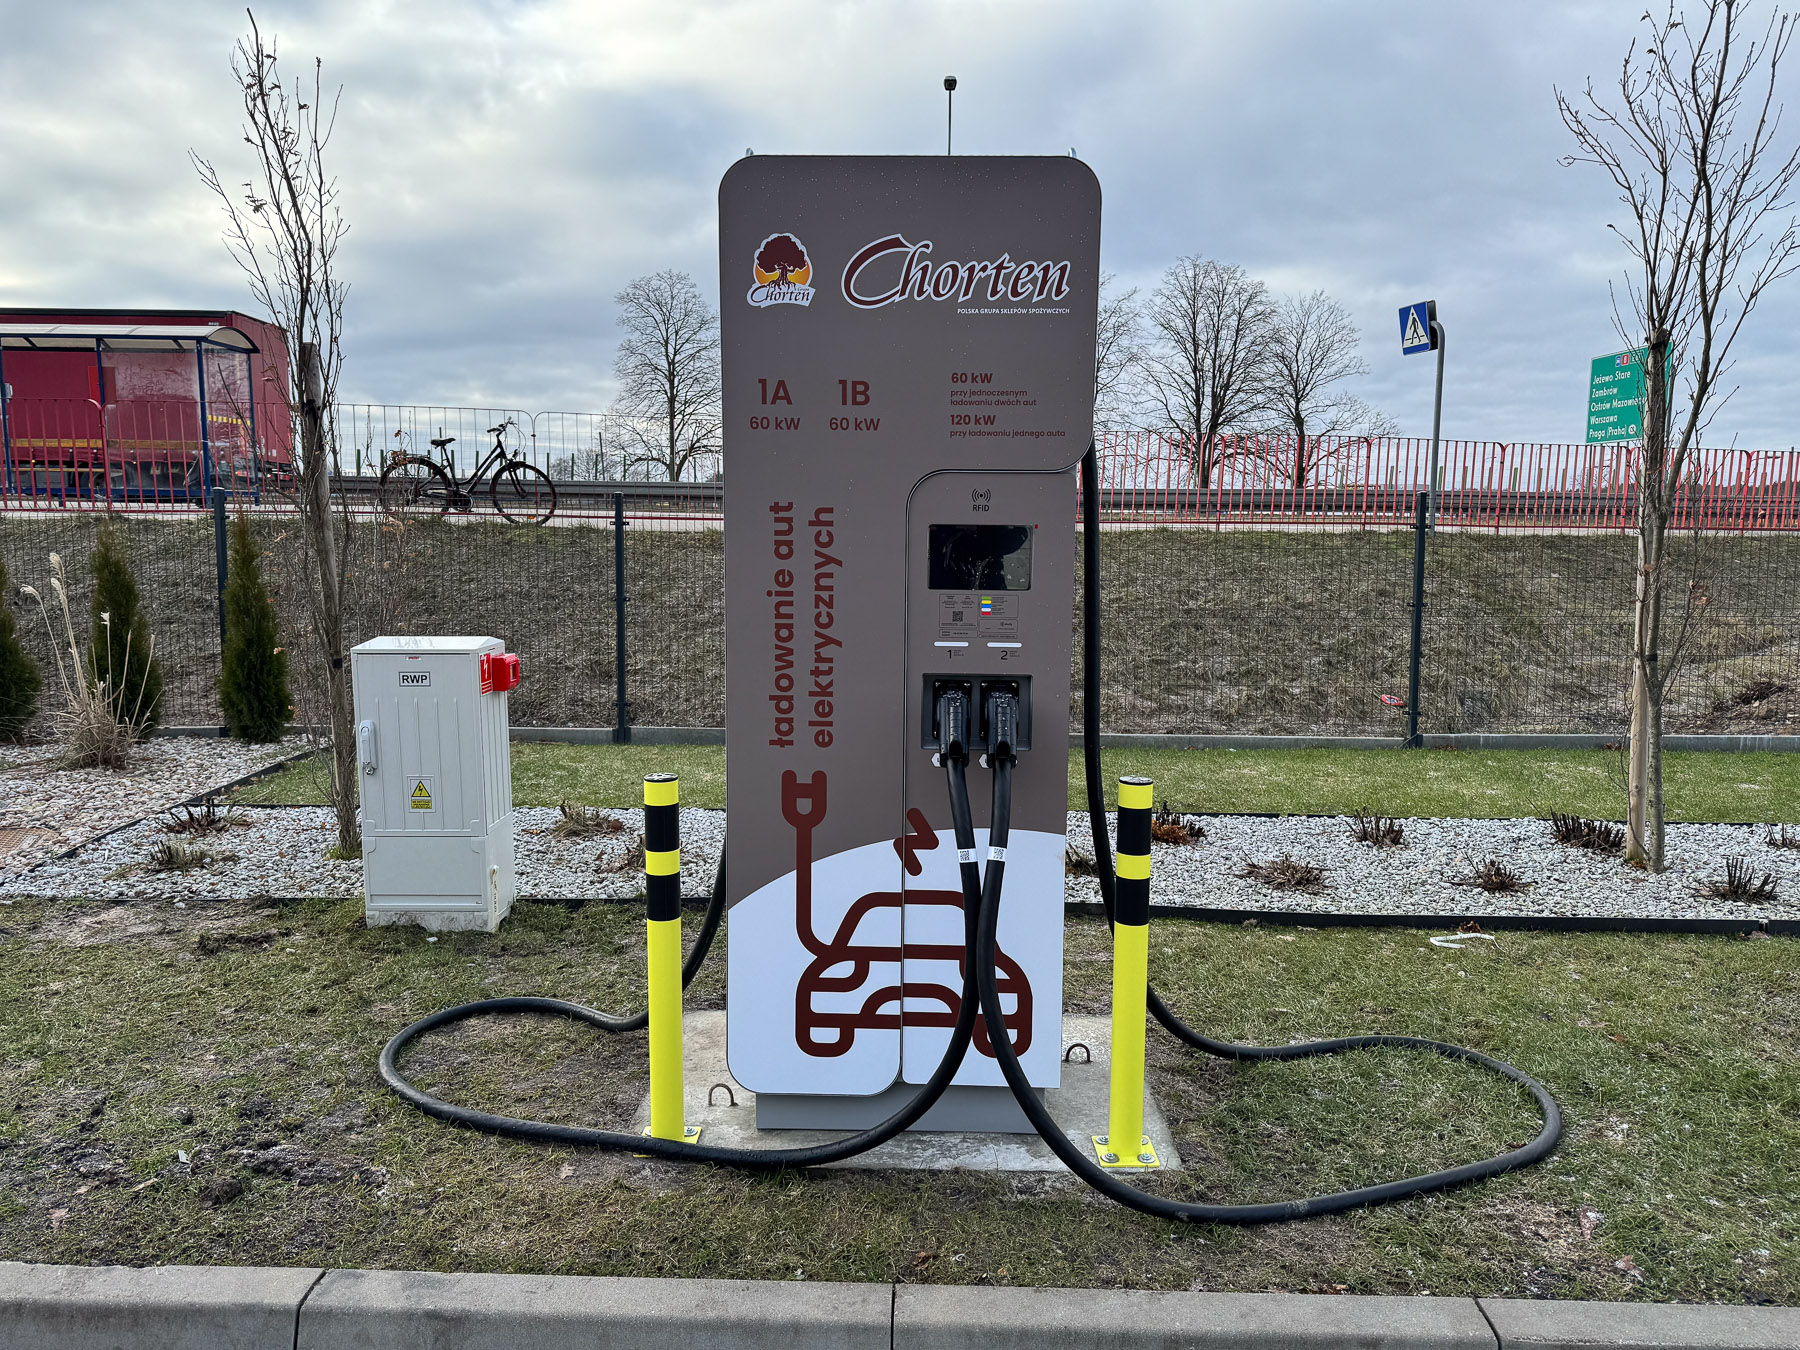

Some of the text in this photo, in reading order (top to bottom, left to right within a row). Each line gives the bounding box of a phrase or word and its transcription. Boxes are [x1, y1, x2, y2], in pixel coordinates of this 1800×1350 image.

[841, 233, 1071, 309] Chorten
[750, 284, 811, 304] Chorten
[951, 372, 993, 384] 60 kW
[1593, 371, 1631, 384] Jeżewo Stare
[757, 378, 793, 405] 1A
[838, 379, 871, 406] 1B
[950, 389, 1028, 398] przy jednoczesnym
[1592, 386, 1618, 398] Zambrów
[1591, 401, 1611, 411] Ostrów
[749, 416, 801, 431] 60 kW
[829, 417, 881, 431] 60 kW
[950, 414, 997, 426] 120 kW
[1590, 415, 1618, 425] Warszawa
[950, 430, 967, 439] przy
[968, 429, 1011, 437] ładowaniu
[1011, 429, 1045, 439] jednego
[1589, 429, 1605, 439] Praga
[1607, 424, 1627, 438] (Praha)
[972, 504, 990, 512] RFID
[766, 501, 794, 749] ładowanie aut
[808, 506, 843, 748] elektrycznych
[947, 649, 952, 660] 1
[1000, 650, 1008, 660] 2
[402, 675, 428, 684] RWP
